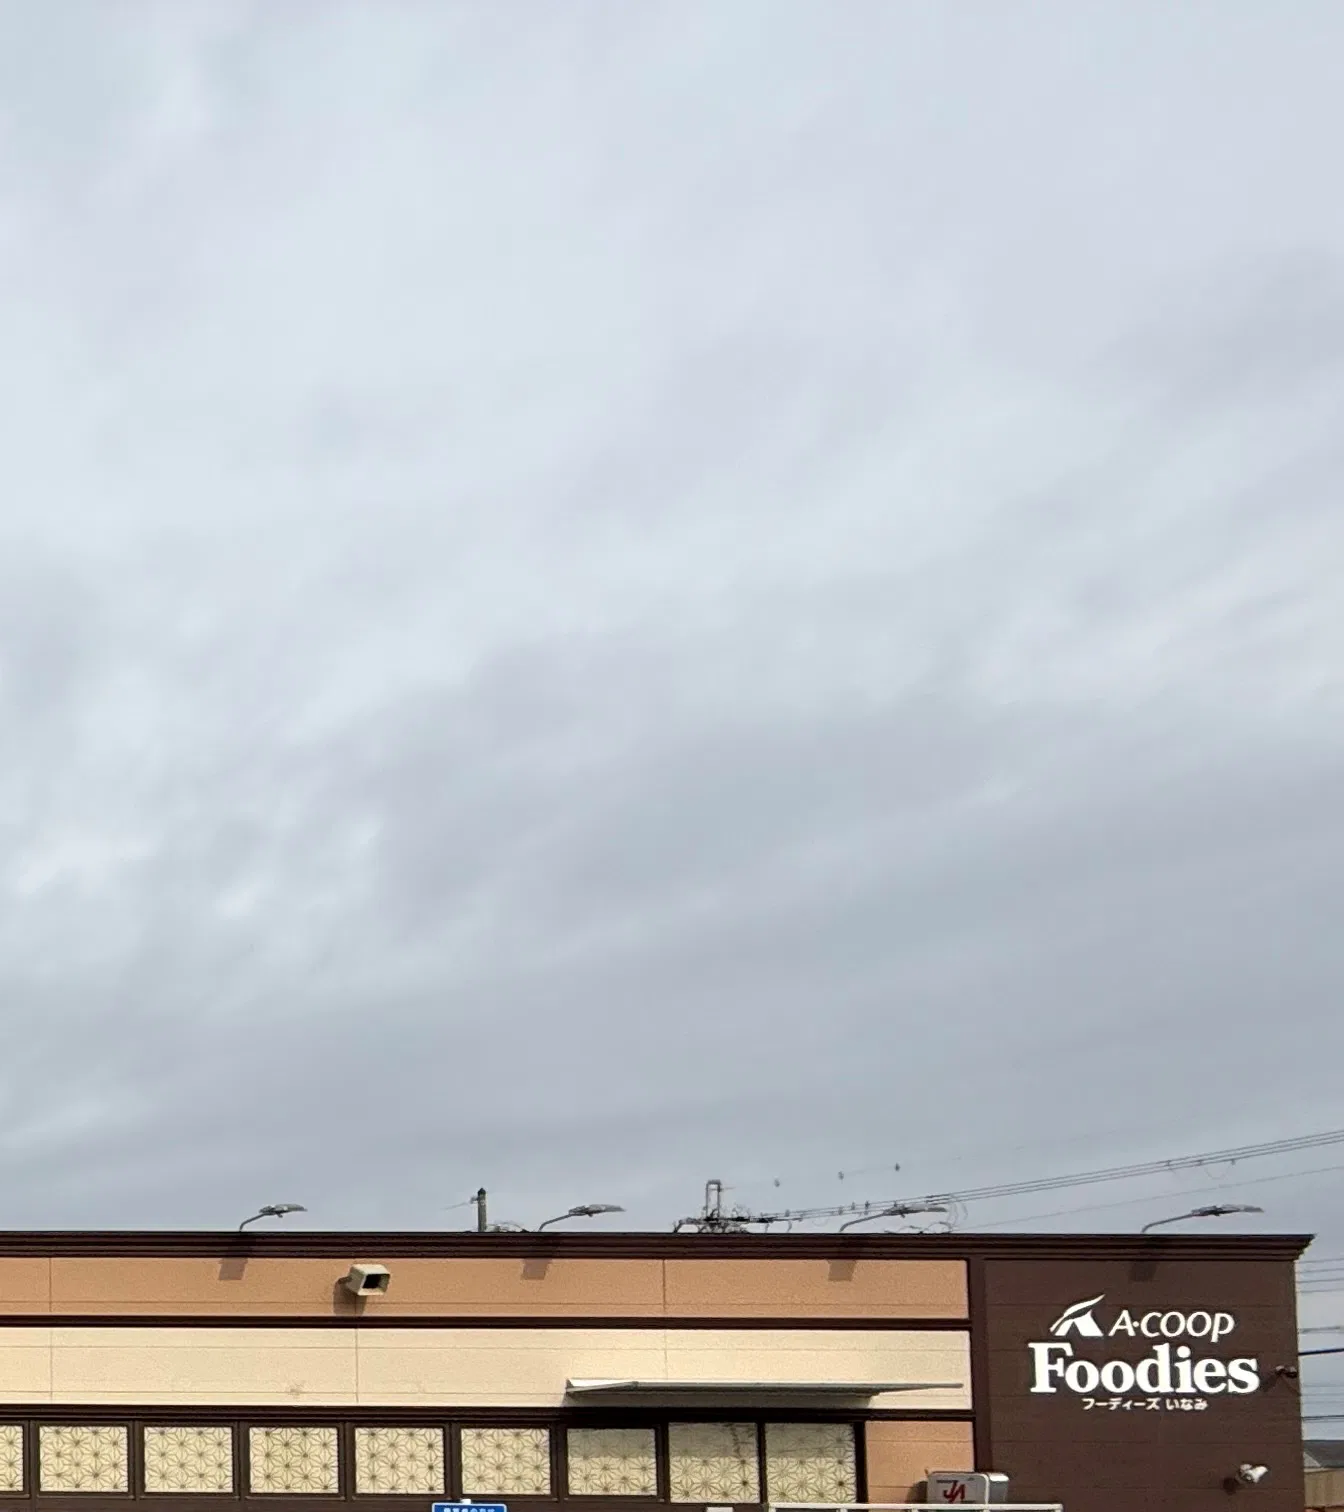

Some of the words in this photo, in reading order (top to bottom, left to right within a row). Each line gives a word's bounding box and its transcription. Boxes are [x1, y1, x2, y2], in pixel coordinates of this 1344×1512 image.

[1028, 1342, 1261, 1394] Foodies
[1081, 1397, 1161, 1411] フーディーズ
[1165, 1398, 1209, 1411] いなみ
